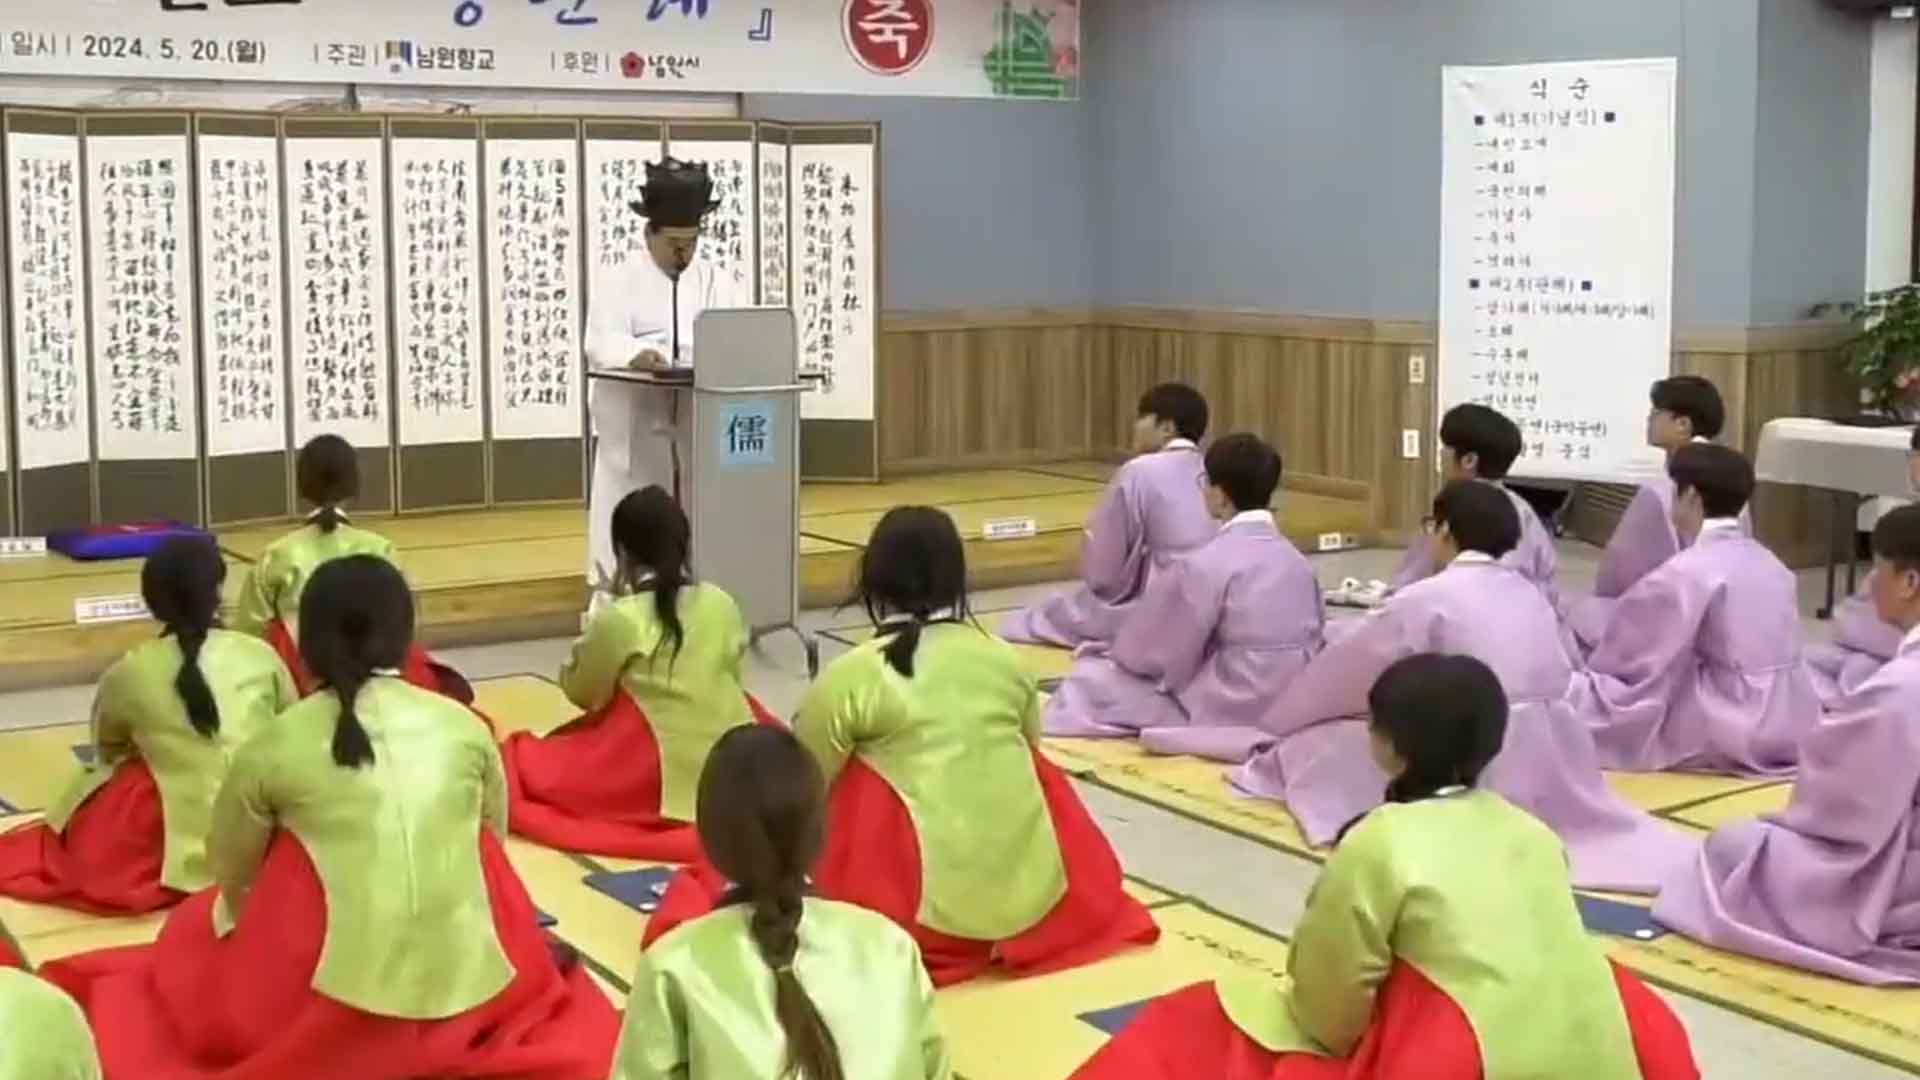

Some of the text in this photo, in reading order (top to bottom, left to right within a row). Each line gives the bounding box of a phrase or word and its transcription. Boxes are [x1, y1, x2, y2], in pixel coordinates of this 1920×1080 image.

[11, 31, 266, 64] 일시 2024. 5. 20.(월)
[327, 43, 496, 71] 주관 남원향교
[563, 51, 700, 79] 후원 남원시
[727, 413, 768, 454] 儒
